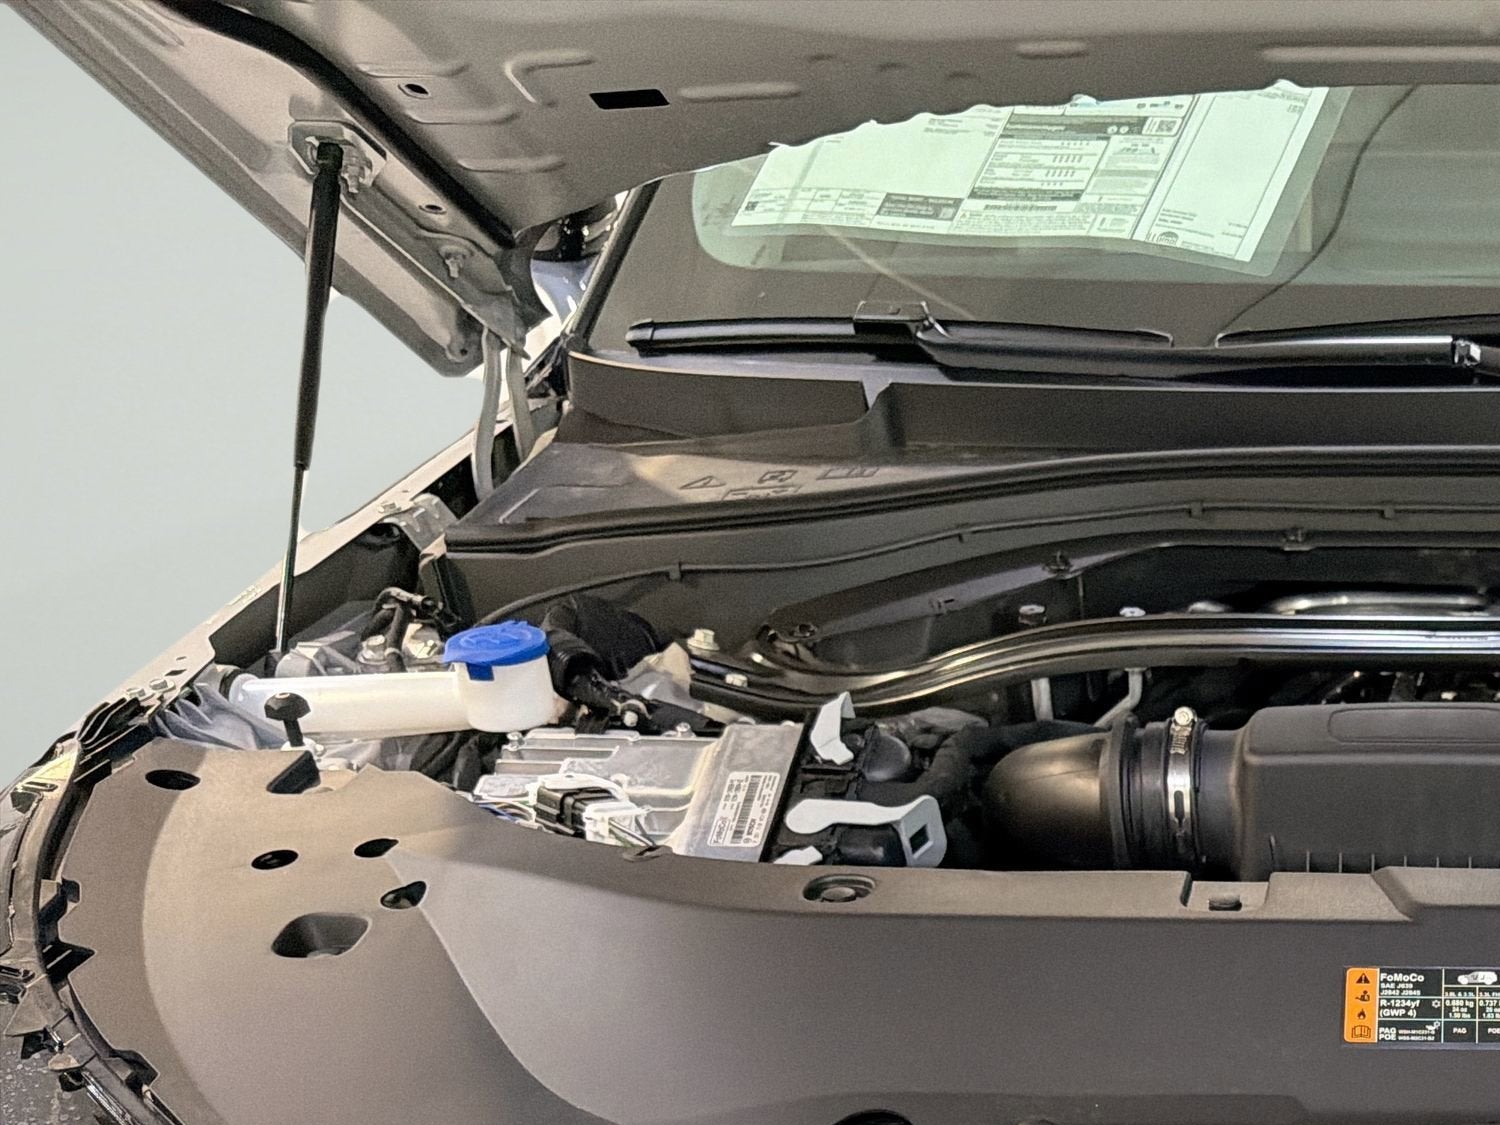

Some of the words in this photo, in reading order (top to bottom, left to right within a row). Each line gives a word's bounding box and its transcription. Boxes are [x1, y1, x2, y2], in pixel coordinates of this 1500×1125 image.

[1380, 973, 1424, 982] FoMoCo
[1380, 999, 1420, 1009] R-1234yf
[1465, 999, 1475, 1008] kg
[1479, 999, 1498, 1007] 0.737
[1379, 1008, 1407, 1018] (GWP
[1407, 1008, 1417, 1019] 4)
[1452, 1027, 1468, 1035] PAG
[1379, 1033, 1396, 1041] POE
